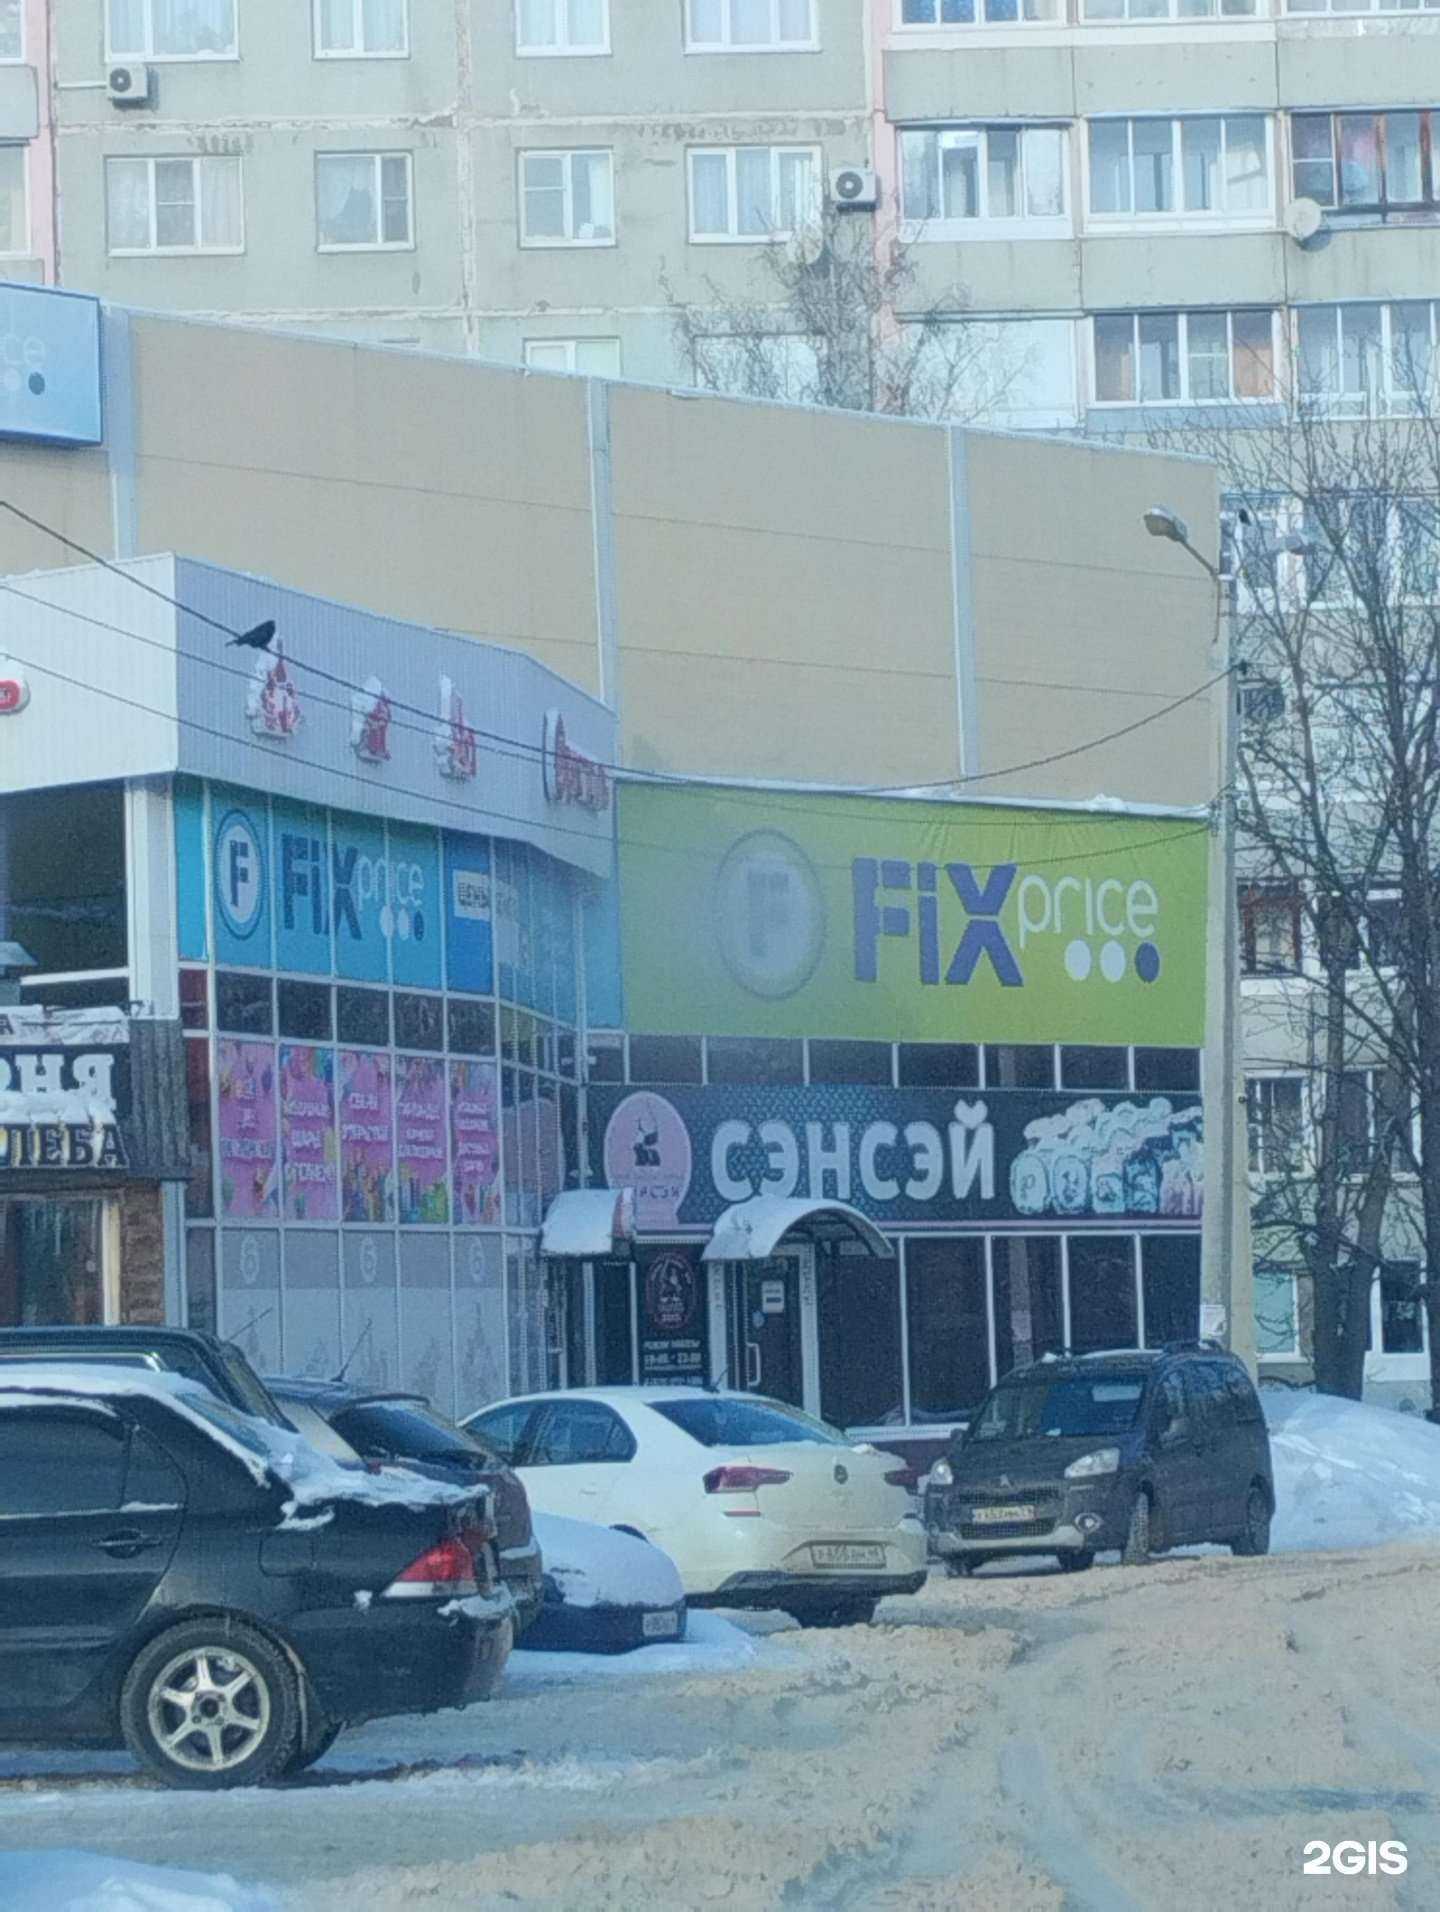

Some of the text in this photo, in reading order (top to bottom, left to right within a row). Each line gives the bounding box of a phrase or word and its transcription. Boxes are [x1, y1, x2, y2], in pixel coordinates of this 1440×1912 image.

[1017, 875, 1158, 949] price
[0, 1122, 129, 1167] ЛЕБА
[711, 1099, 995, 1201] СЭНСЭЙ
